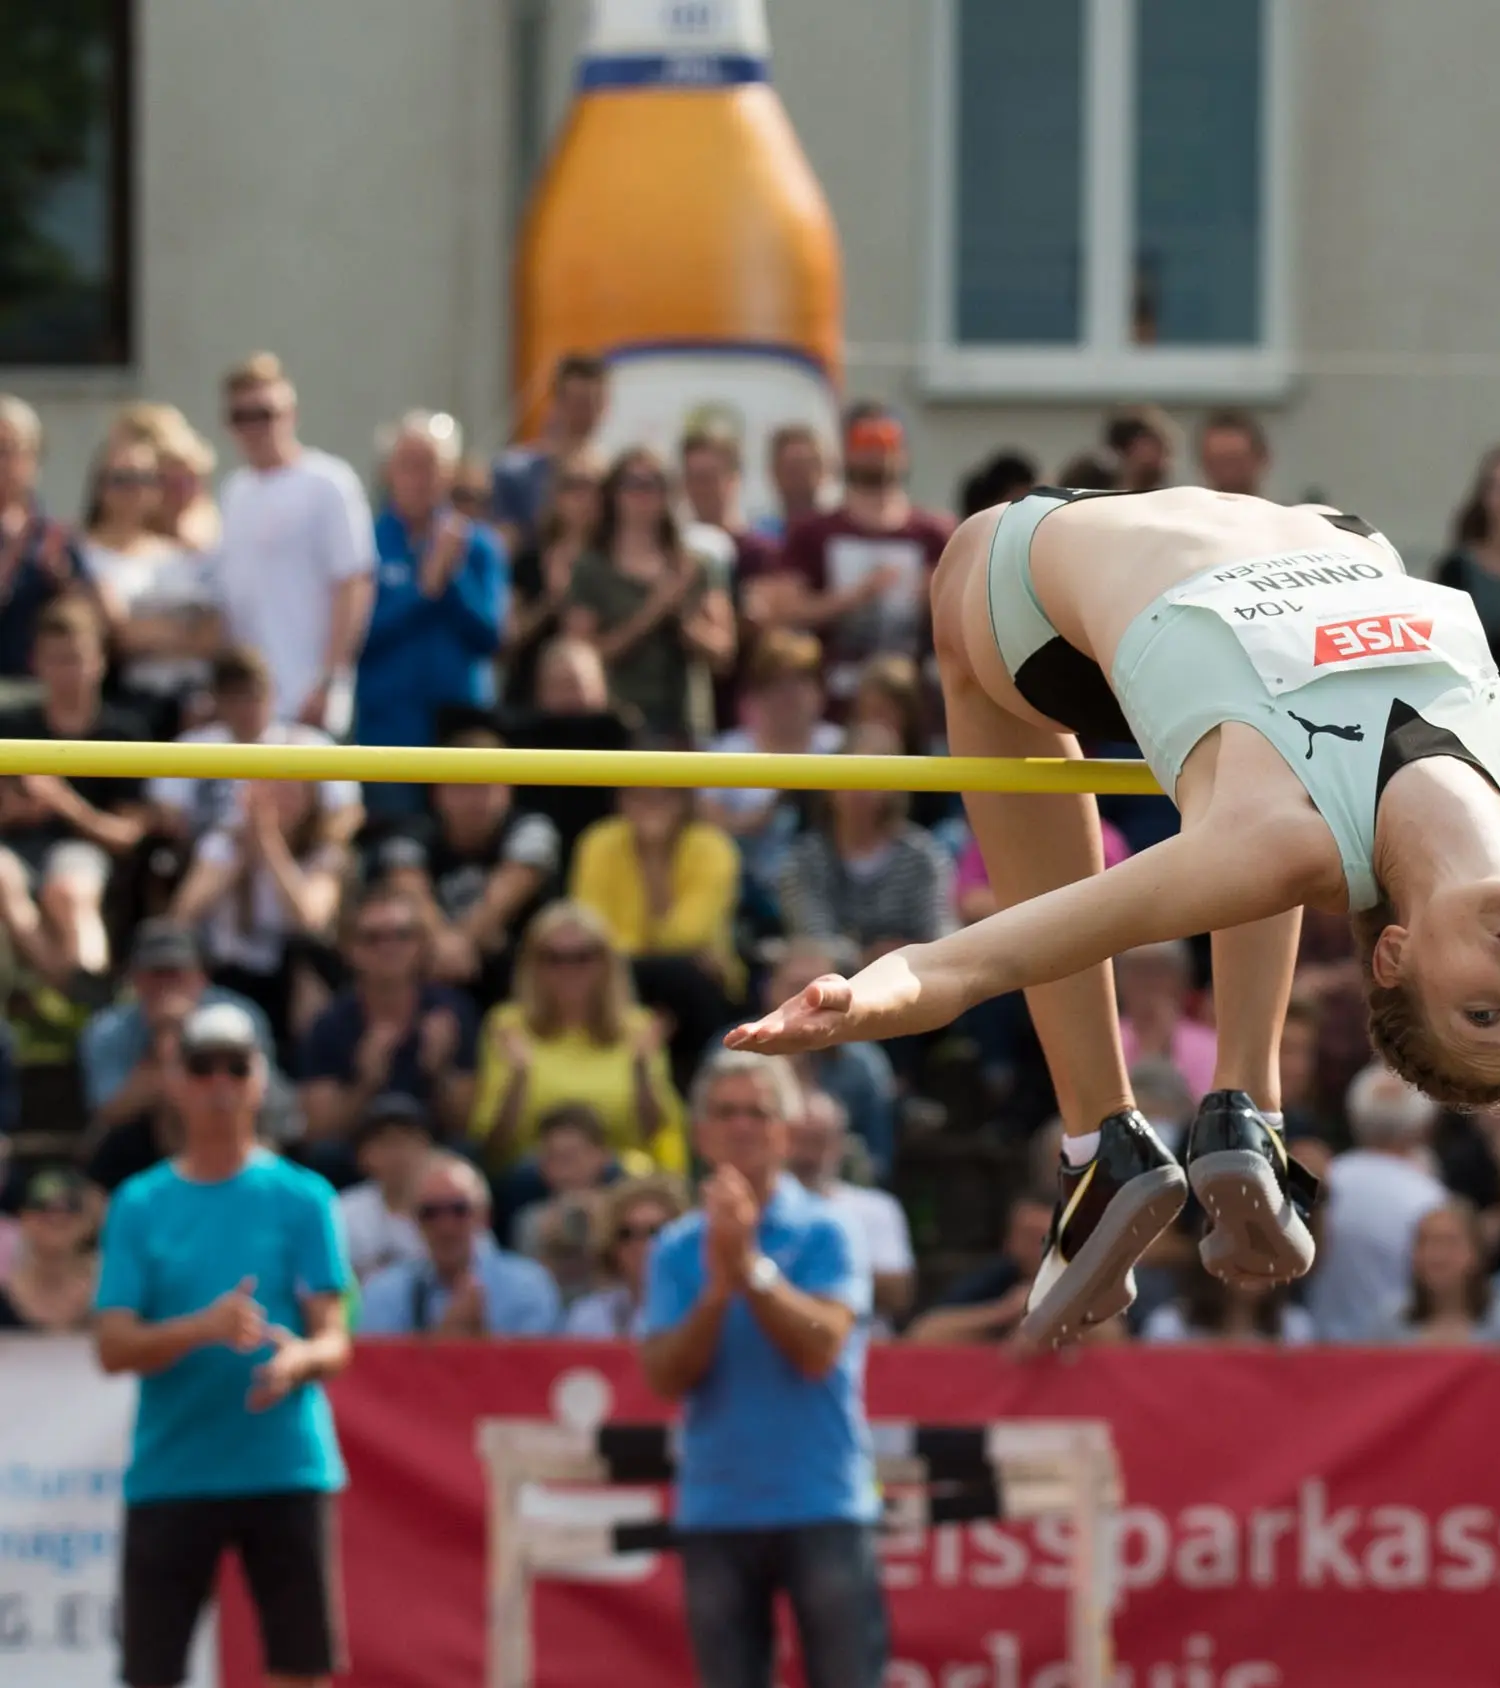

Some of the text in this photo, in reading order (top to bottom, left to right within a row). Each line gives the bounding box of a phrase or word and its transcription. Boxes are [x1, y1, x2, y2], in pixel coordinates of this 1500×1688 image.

[1247, 563, 1383, 592] ONNEN
[1234, 599, 1304, 621] 104
[1323, 616, 1427, 656] VSE
